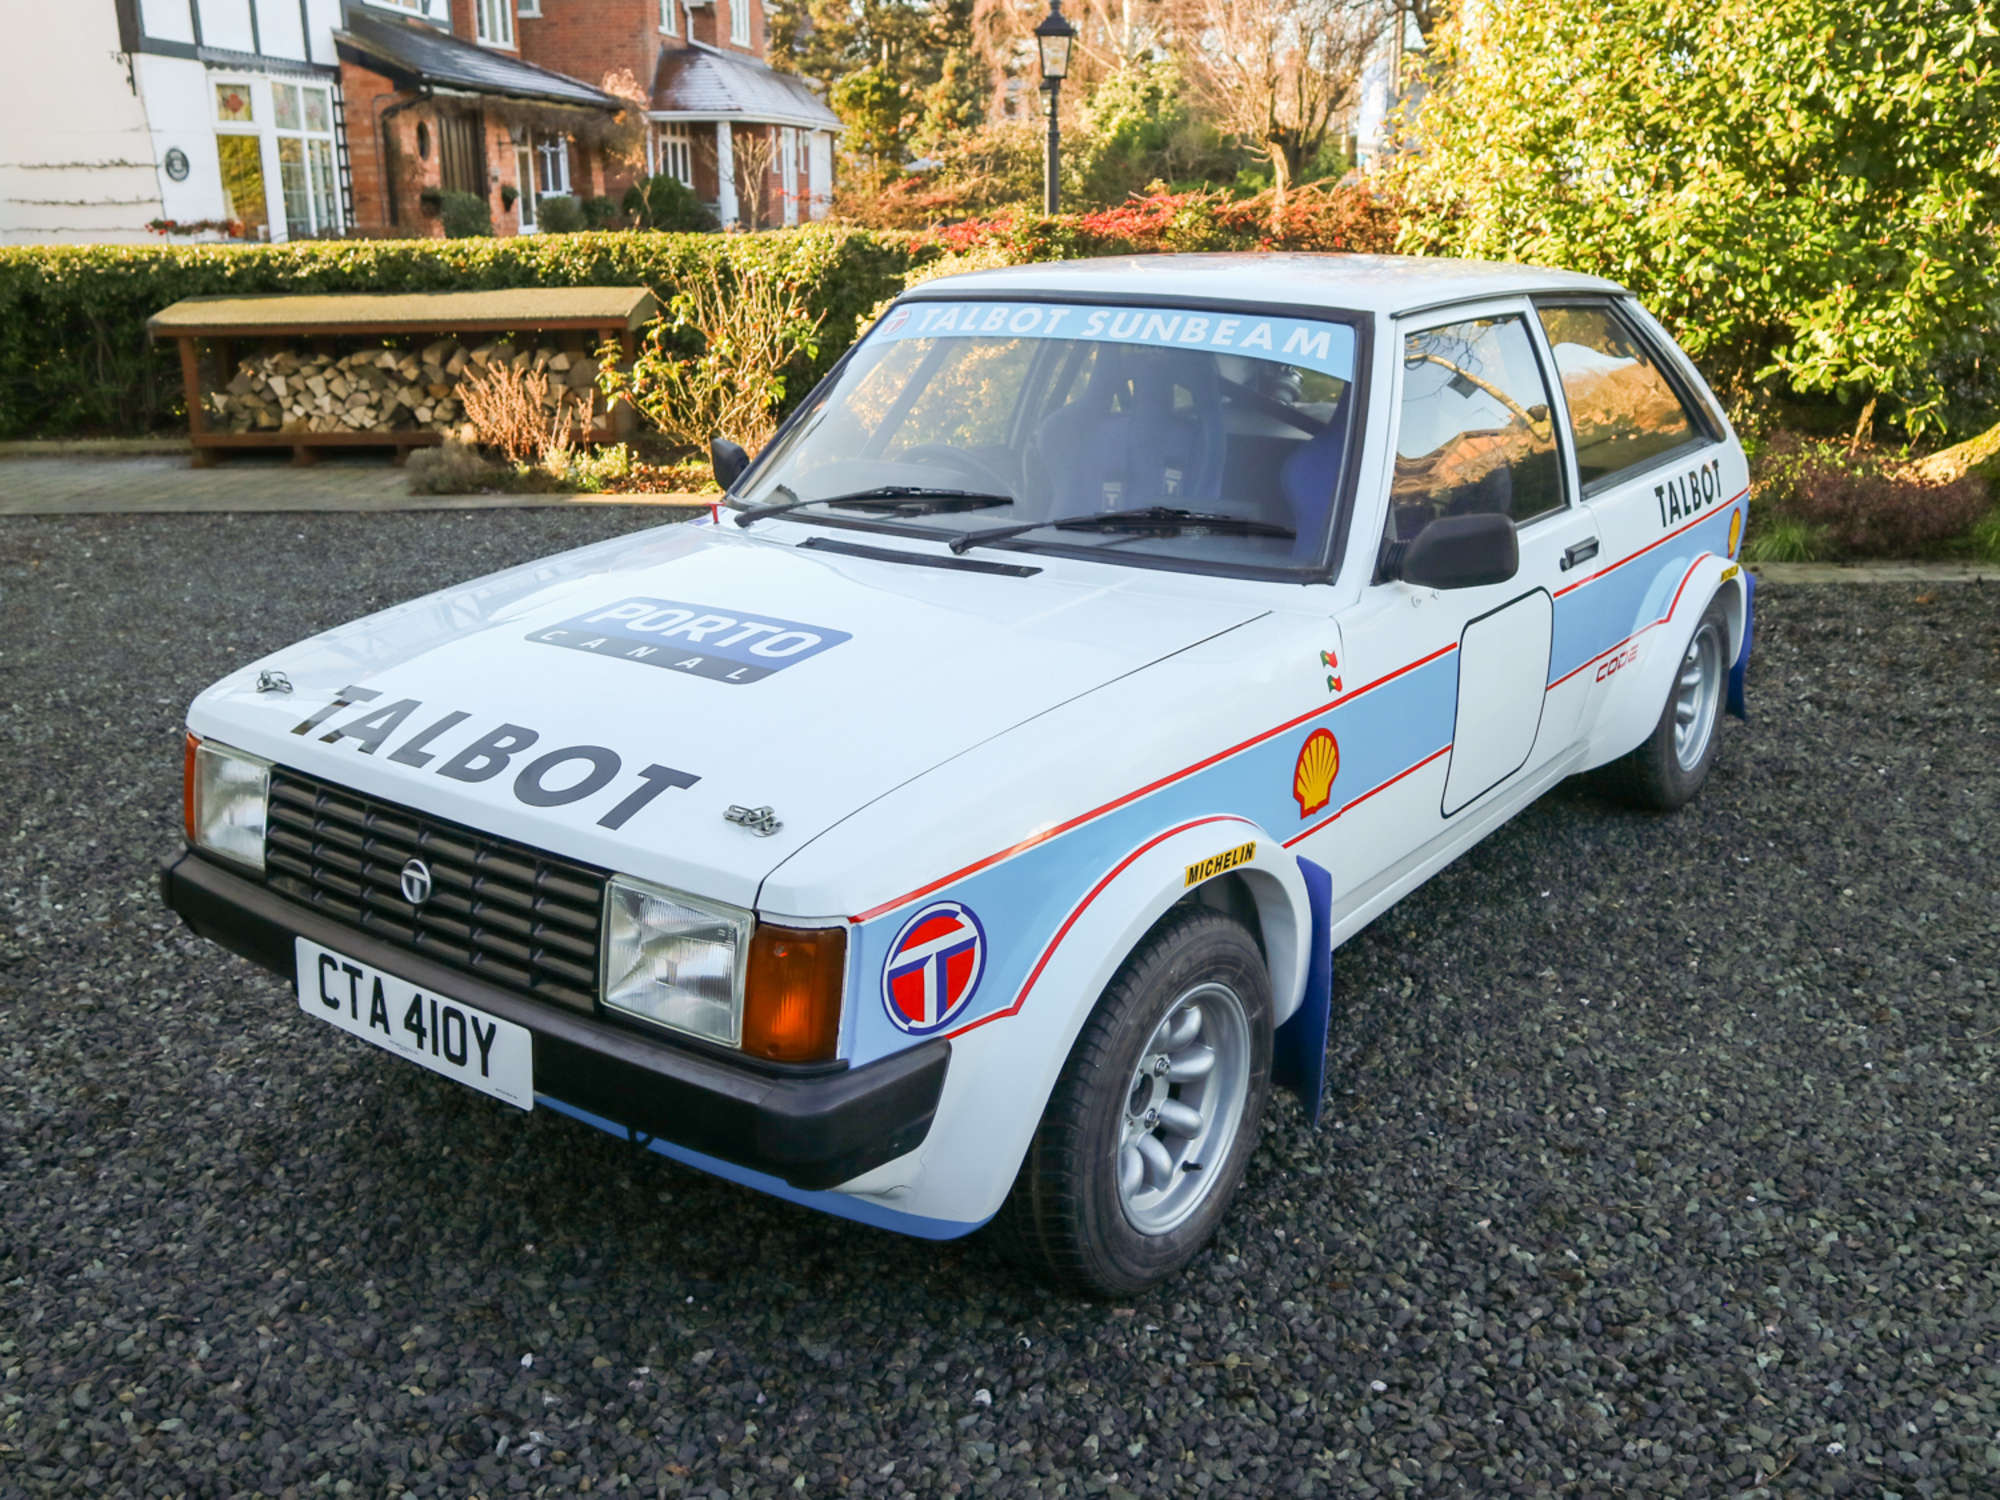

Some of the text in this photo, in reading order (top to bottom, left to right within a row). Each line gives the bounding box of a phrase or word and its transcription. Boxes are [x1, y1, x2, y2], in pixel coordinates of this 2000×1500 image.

[916, 306, 1332, 360] TALBOT SUNBEAM
[1654, 458, 1722, 528] TALBOT
[540, 630, 749, 680] CANAL
[583, 602, 823, 658] PORTO
[290, 684, 702, 831] TALBOT
[1187, 841, 1255, 885] MICHELIN
[318, 952, 497, 1079] CTA 410Y
